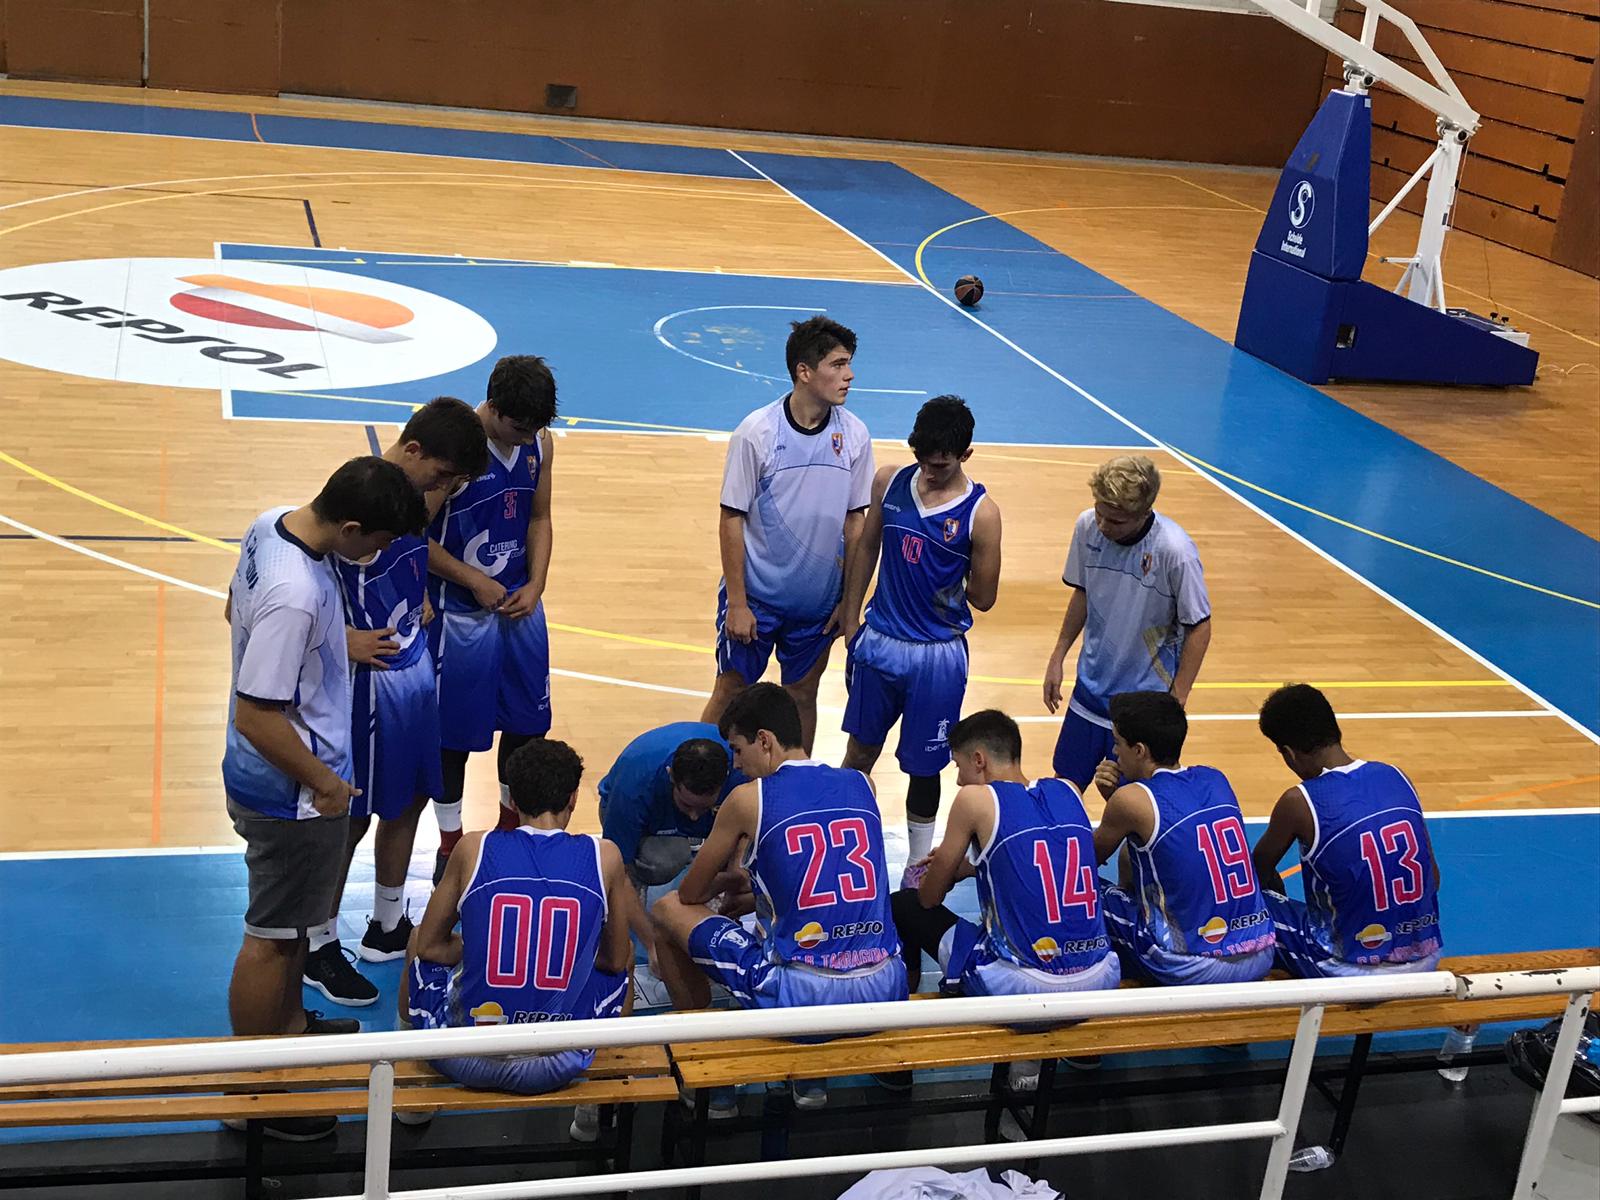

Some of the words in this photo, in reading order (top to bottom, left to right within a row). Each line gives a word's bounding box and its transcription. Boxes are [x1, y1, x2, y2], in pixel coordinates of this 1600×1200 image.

[1, 291, 325, 379] REPSOL
[902, 534, 924, 564] 10
[785, 818, 877, 910] 23
[1034, 837, 1097, 924] 14
[1196, 816, 1256, 904] 19
[1360, 820, 1424, 911] 13
[486, 893, 581, 991] 00
[832, 921, 884, 939] REPSO
